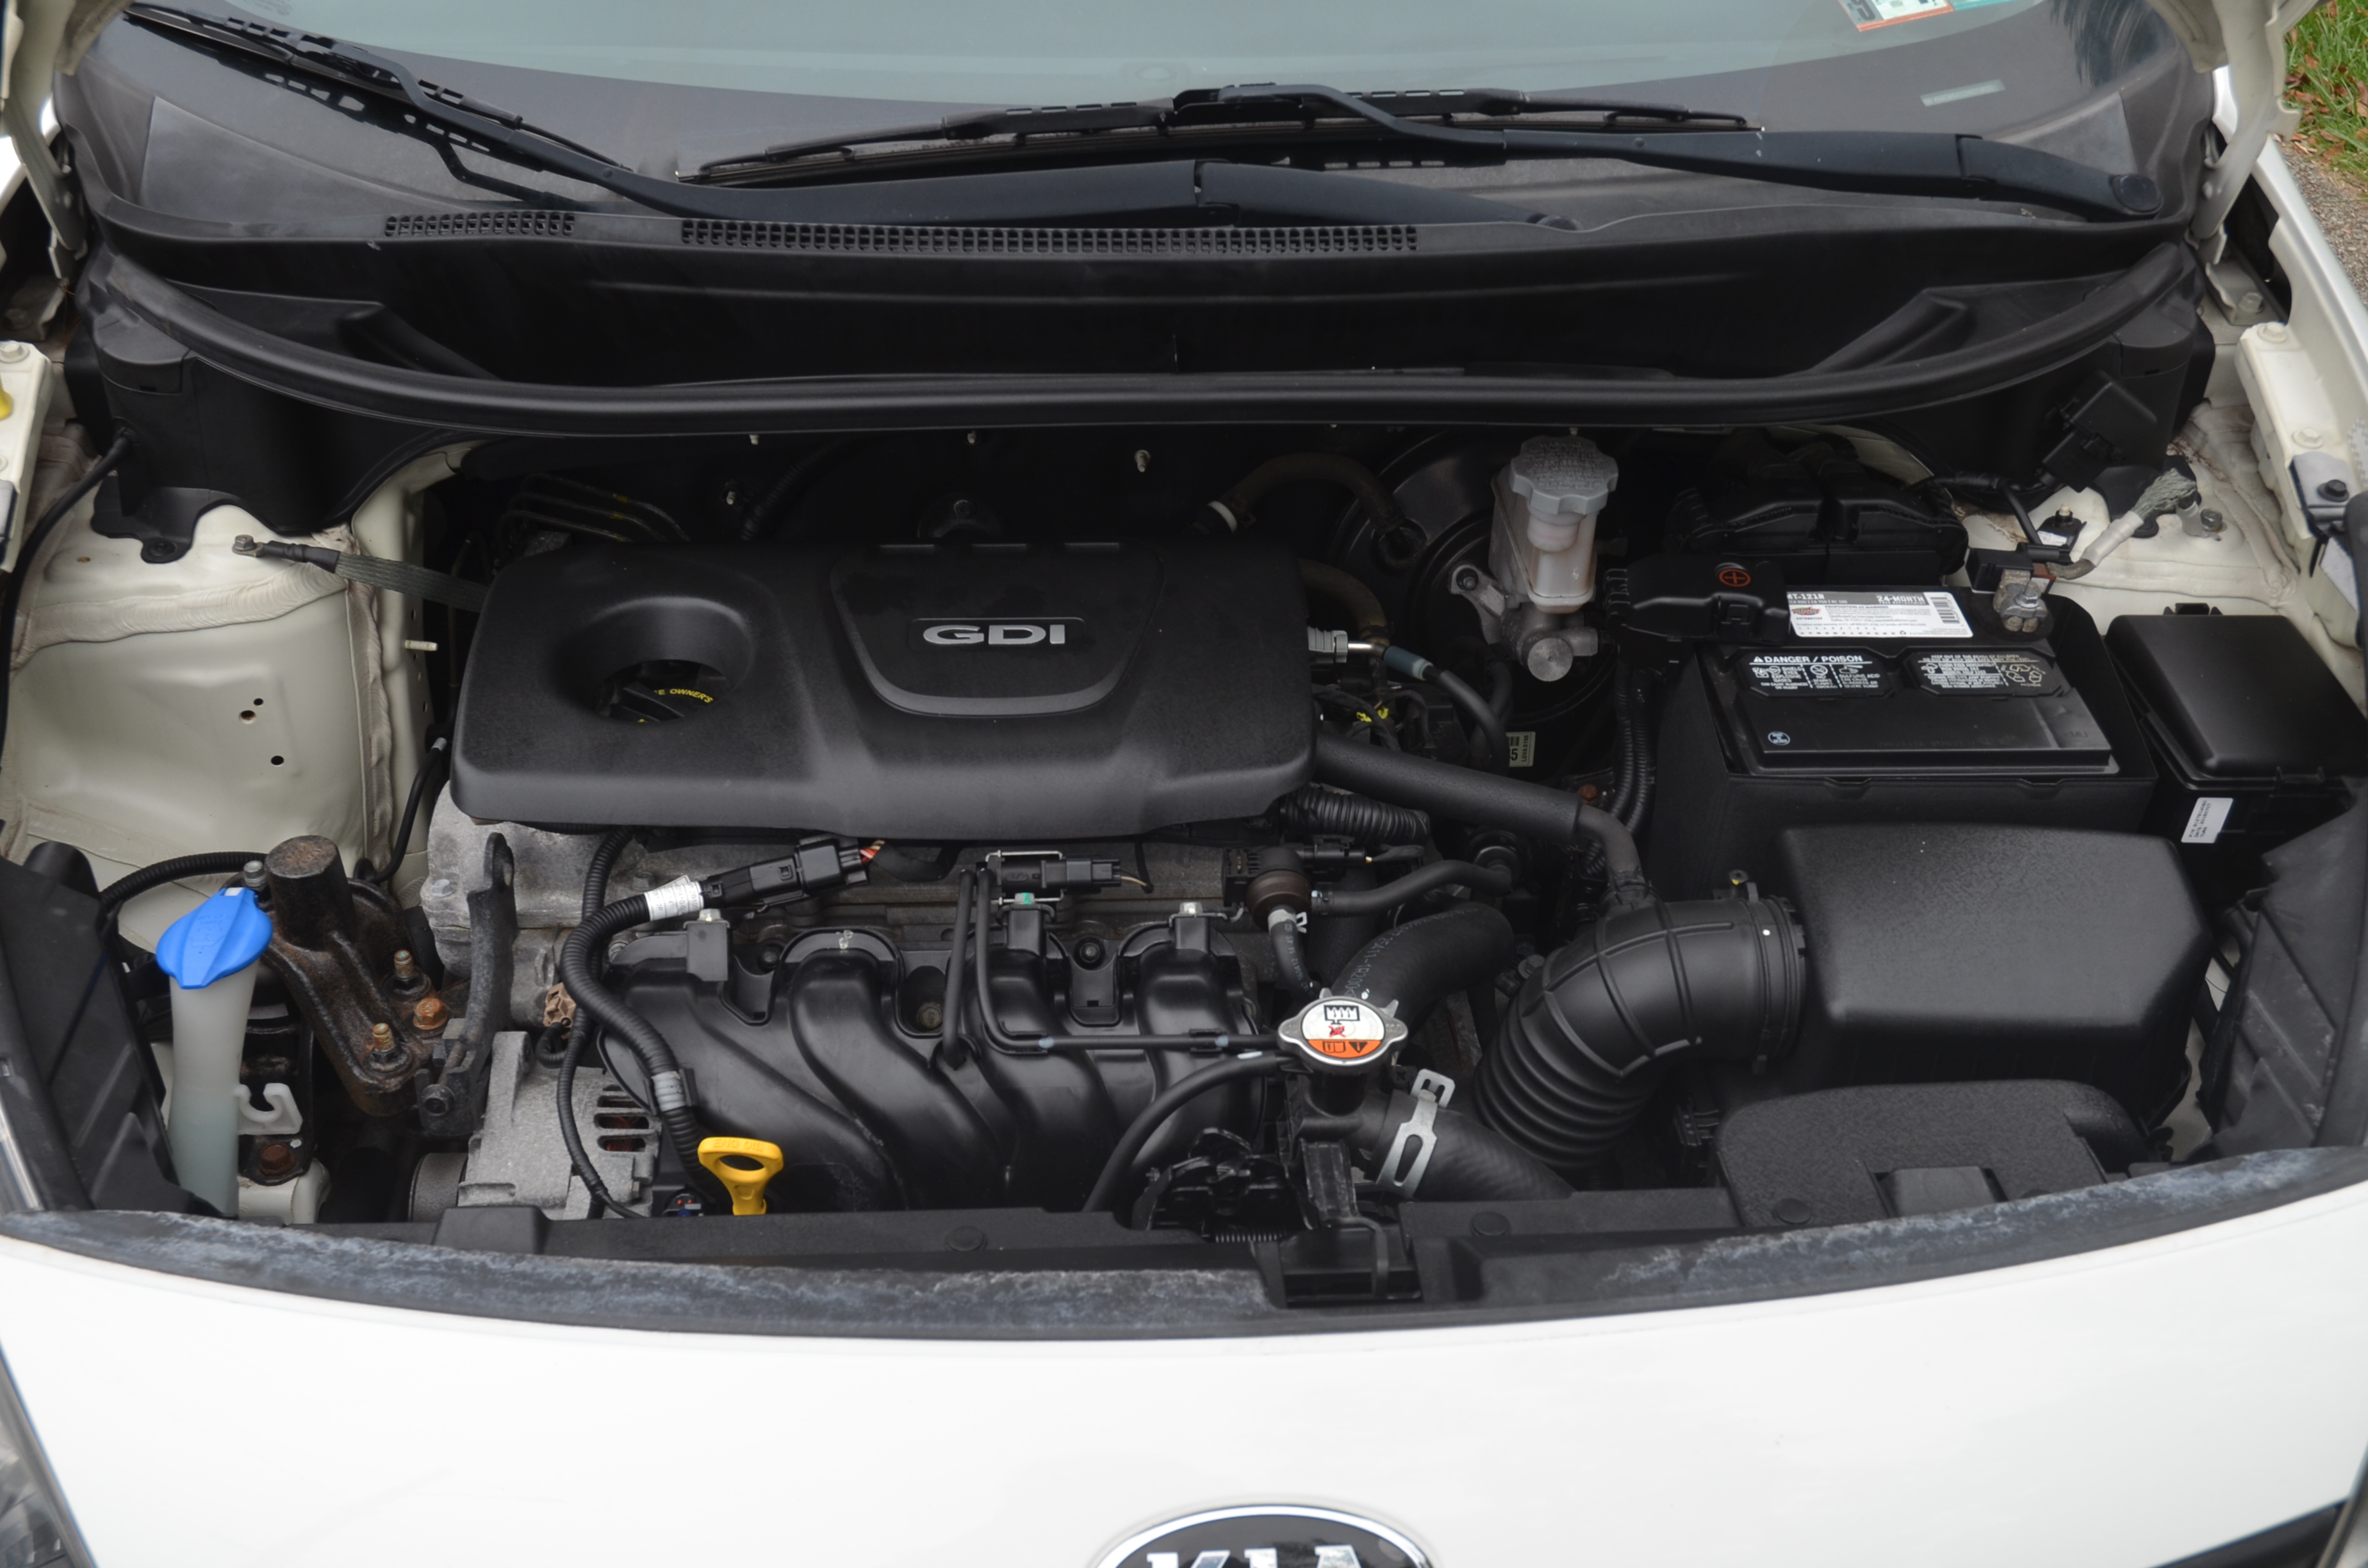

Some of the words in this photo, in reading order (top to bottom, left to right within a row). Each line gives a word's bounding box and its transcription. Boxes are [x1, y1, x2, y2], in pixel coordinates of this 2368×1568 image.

[923, 624, 1067, 645] GDI
[669, 688, 714, 703] OWNER'S
[743, 1140, 763, 1152] OIL
